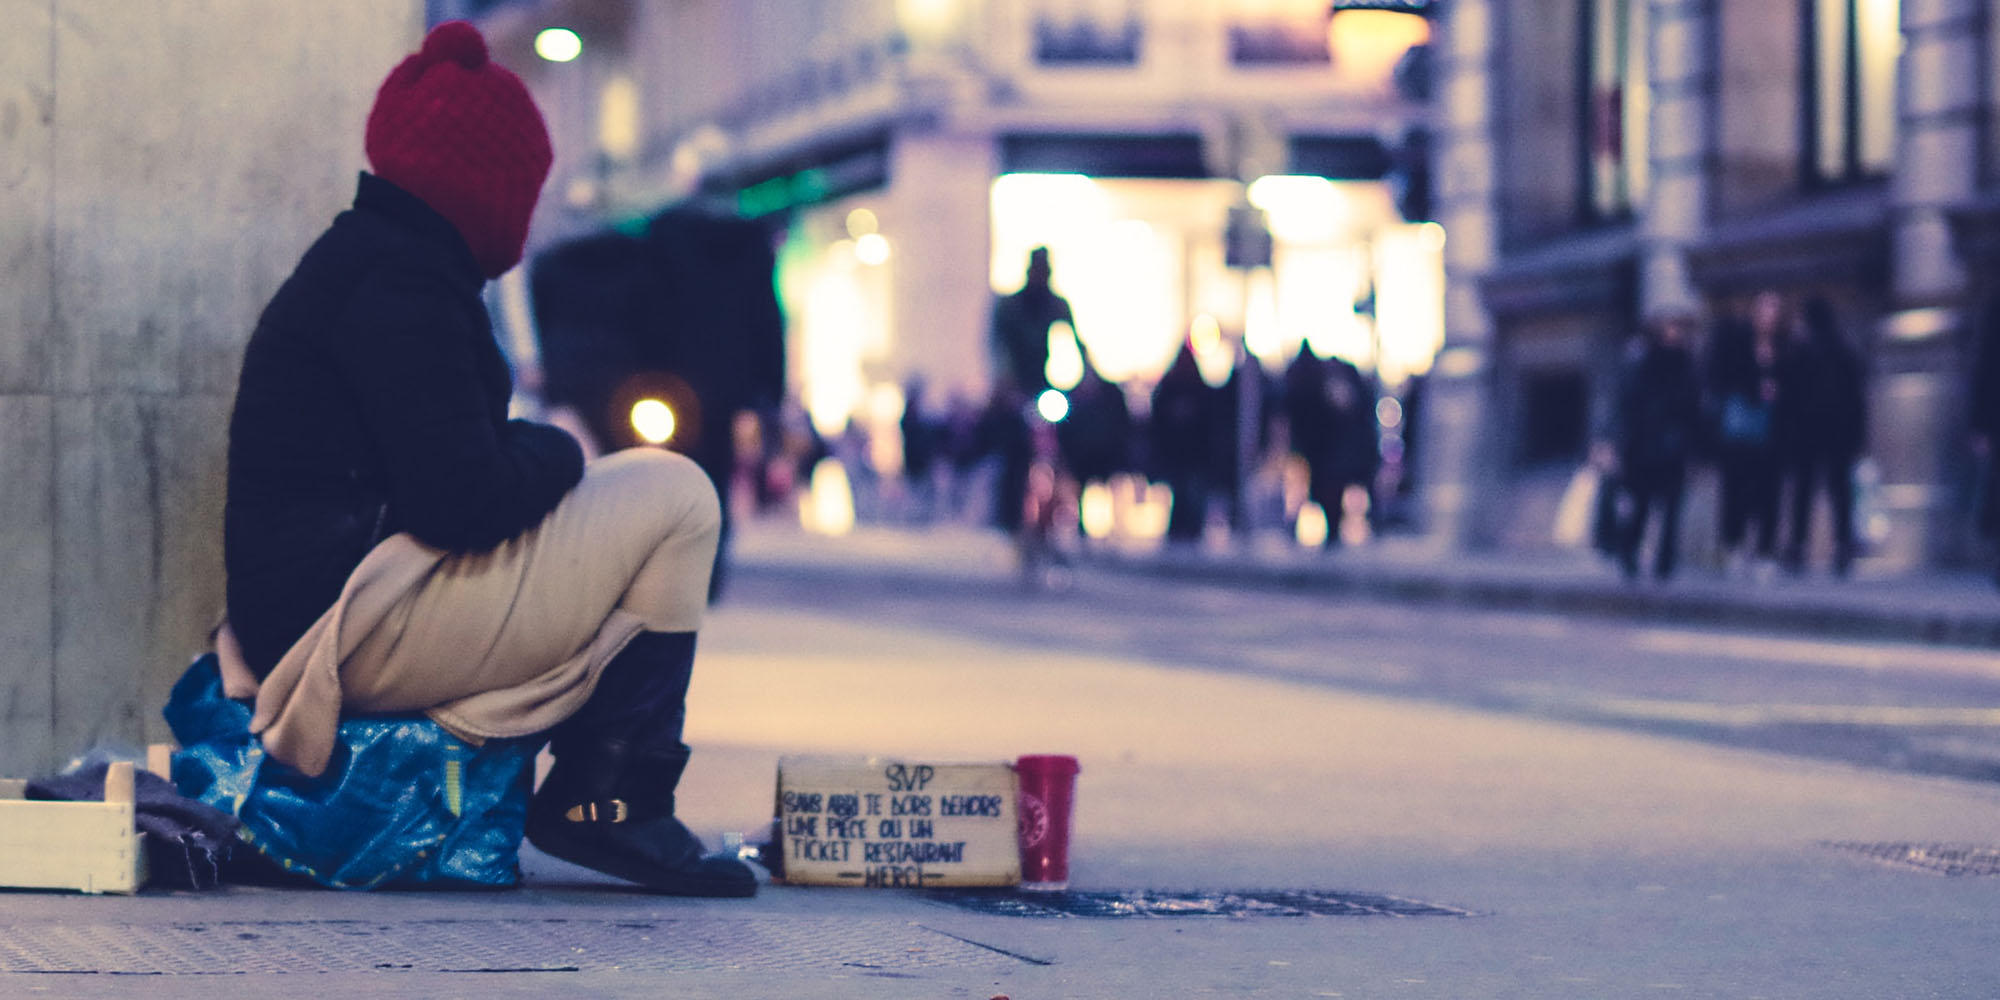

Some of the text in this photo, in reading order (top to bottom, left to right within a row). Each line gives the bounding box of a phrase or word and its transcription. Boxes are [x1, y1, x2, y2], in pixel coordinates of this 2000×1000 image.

[885, 764, 934, 791] SVP
[787, 816, 817, 837] UNE
[878, 819, 902, 838] OU
[791, 838, 966, 863] TICKET RESTAURANT
